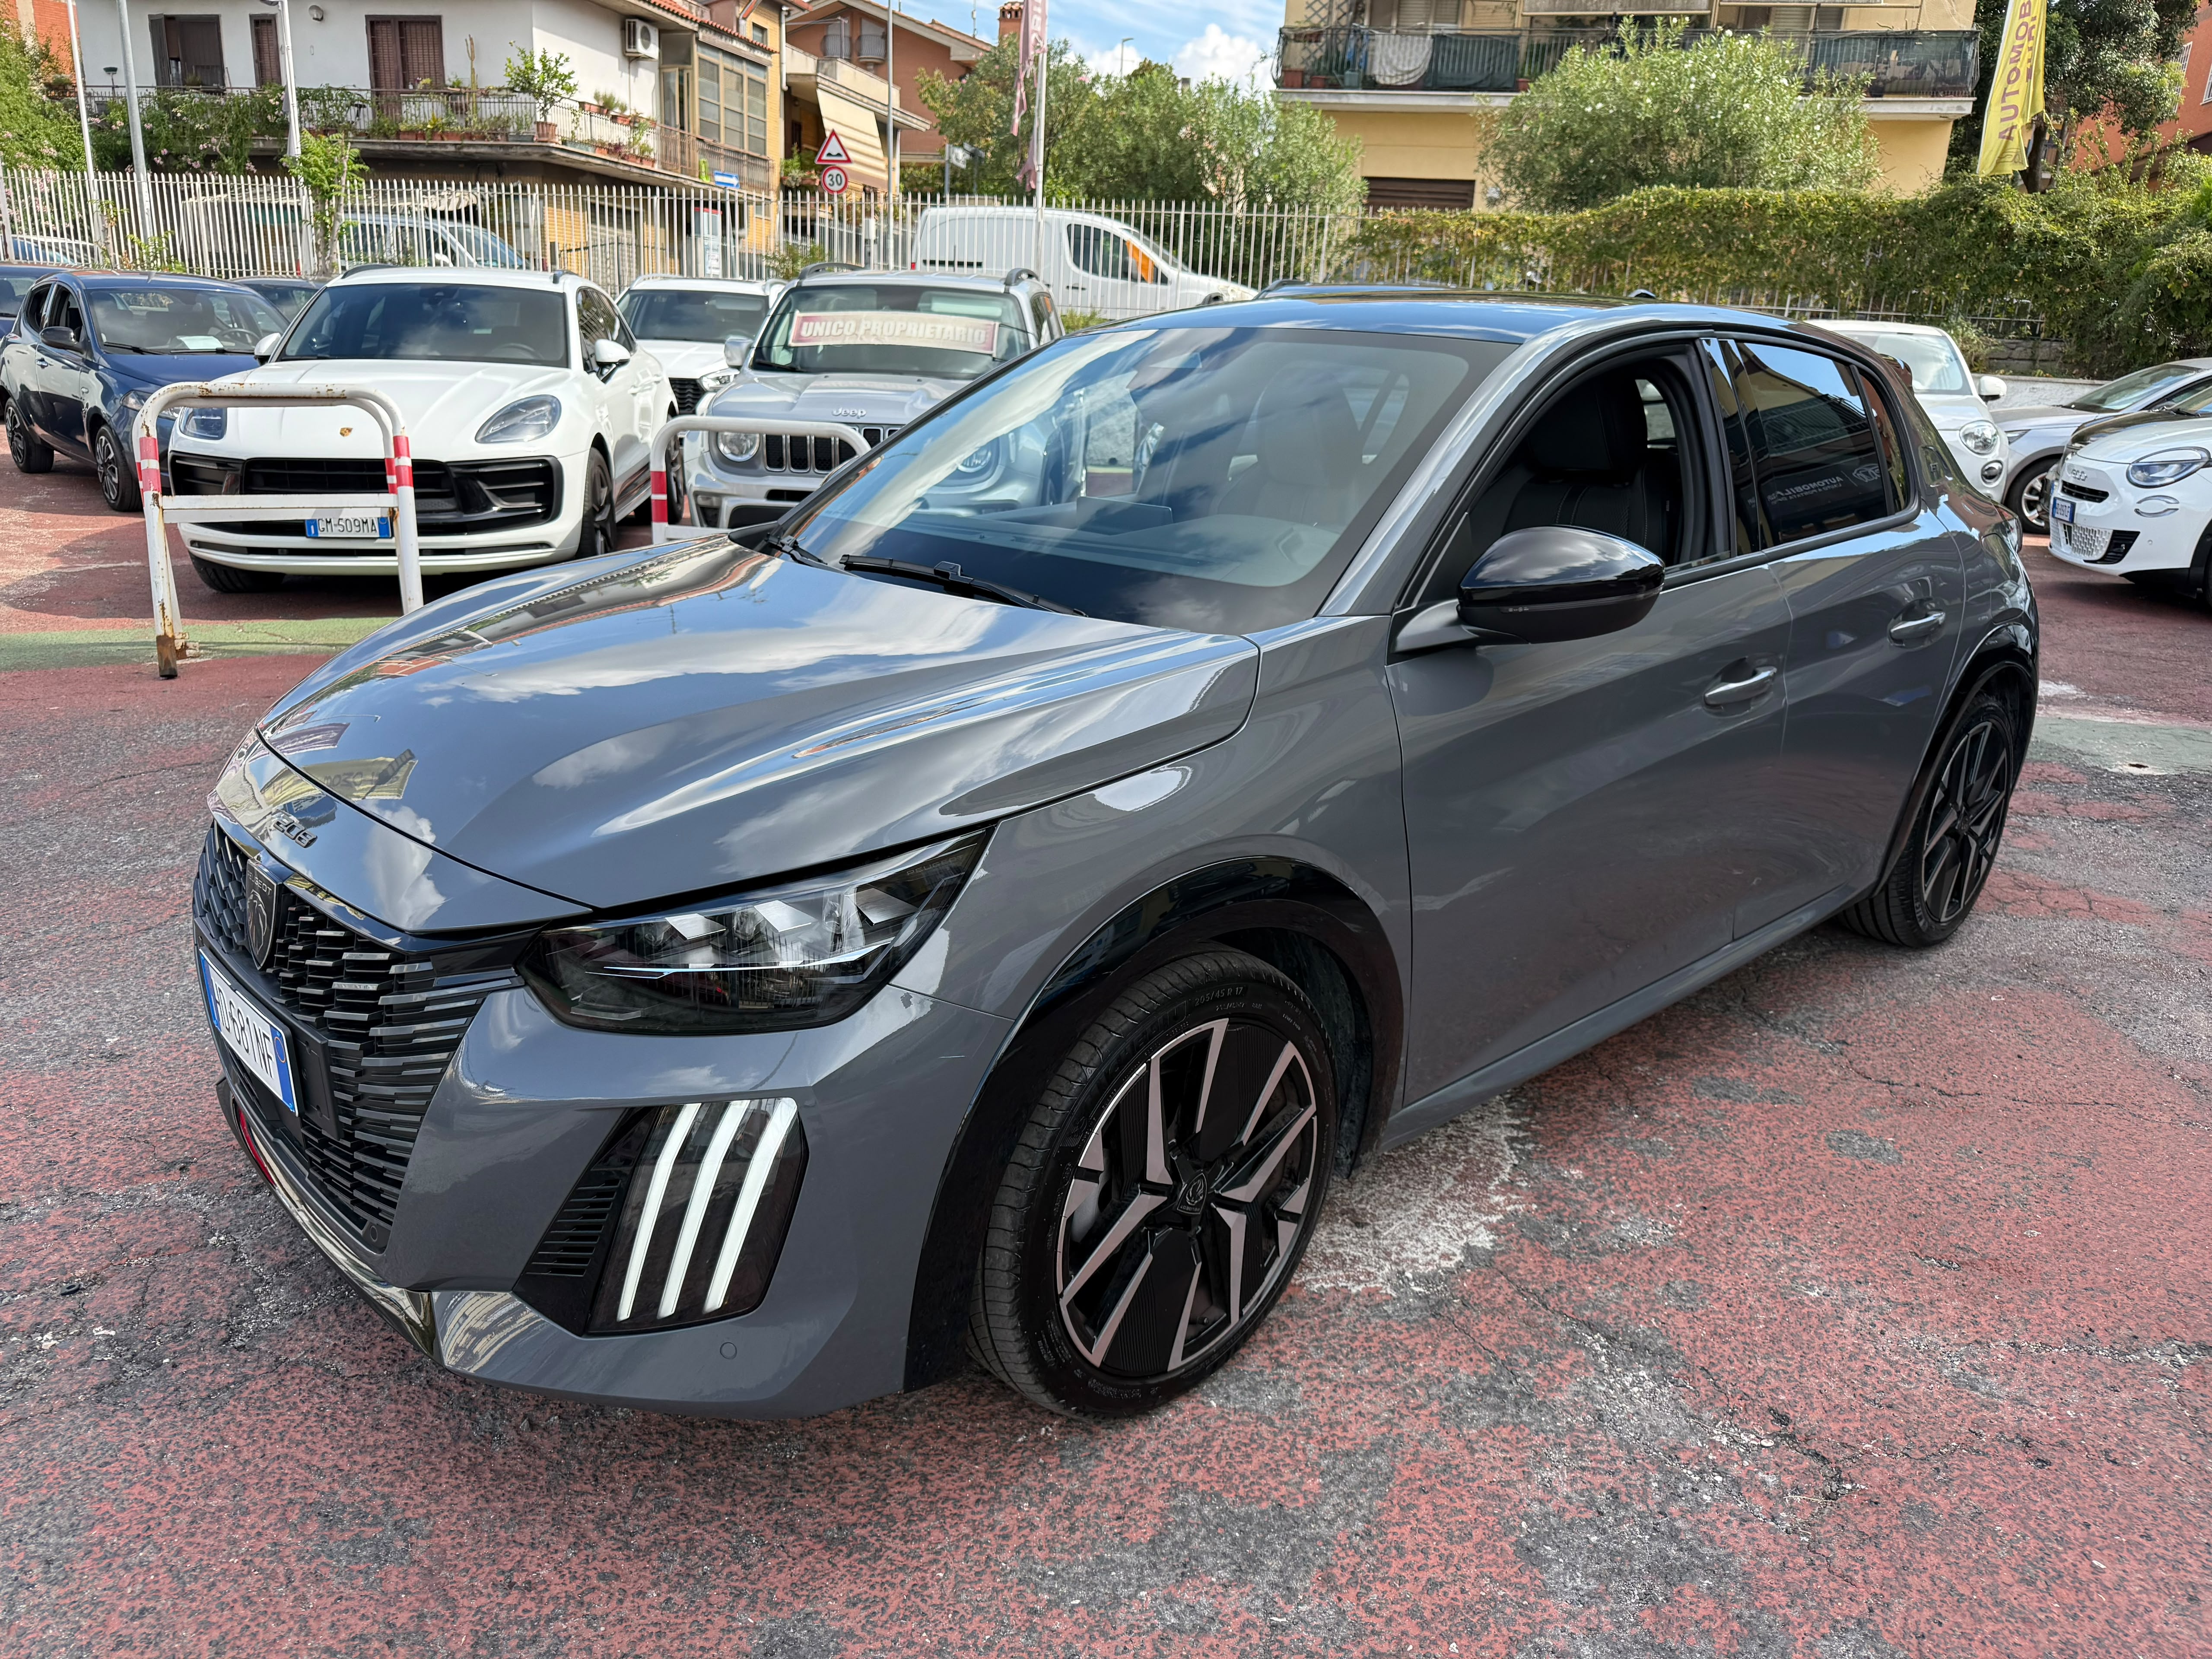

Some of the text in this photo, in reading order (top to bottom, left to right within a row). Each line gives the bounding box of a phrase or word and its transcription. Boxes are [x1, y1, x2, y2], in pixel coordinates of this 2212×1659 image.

[828, 174, 842, 187] 30
[800, 320, 988, 344] UNICO PROPRIETARIO
[831, 407, 867, 419] Jeep
[273, 813, 318, 848] 208
[906, 855, 964, 876] PEUGEOT
[247, 870, 272, 895] PEUGEOT
